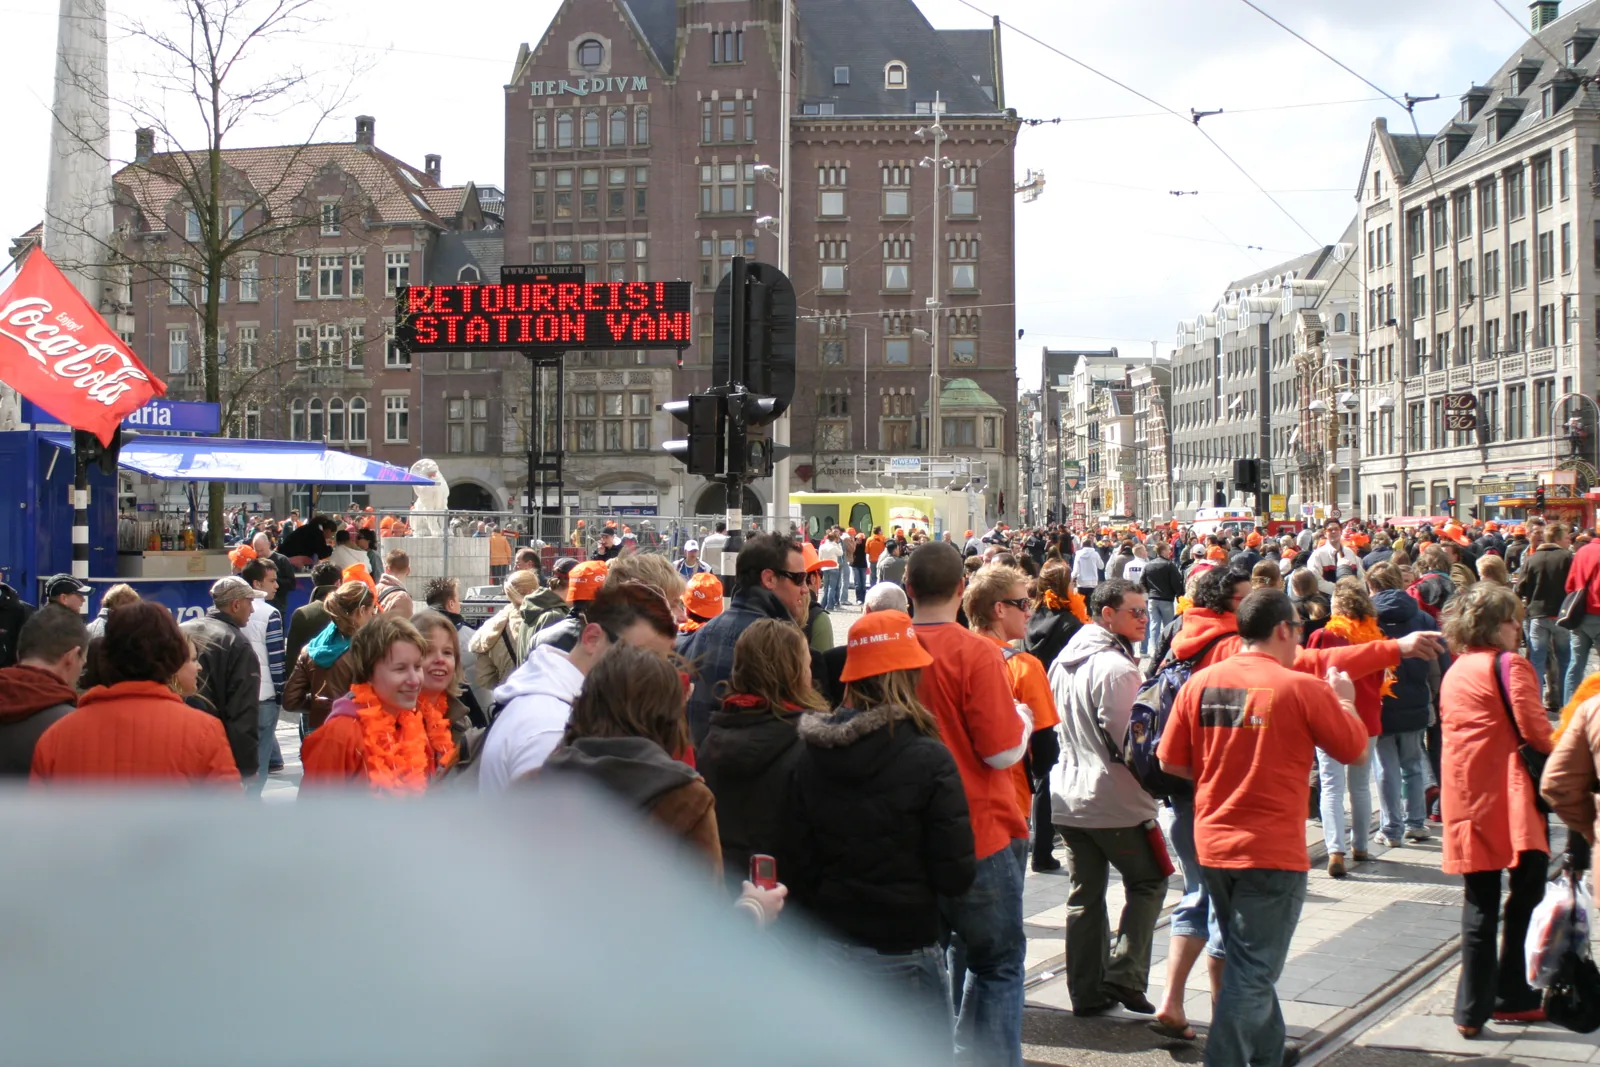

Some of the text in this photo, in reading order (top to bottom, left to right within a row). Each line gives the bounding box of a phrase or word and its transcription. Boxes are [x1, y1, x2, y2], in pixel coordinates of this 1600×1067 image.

[408, 282, 664, 313] RETOURREIS!
[55, 311, 84, 333] Enjoy!
[415, 314, 585, 344] STATION
[0, 297, 149, 406] Coca-Cola
[860, 637, 868, 645] JE
